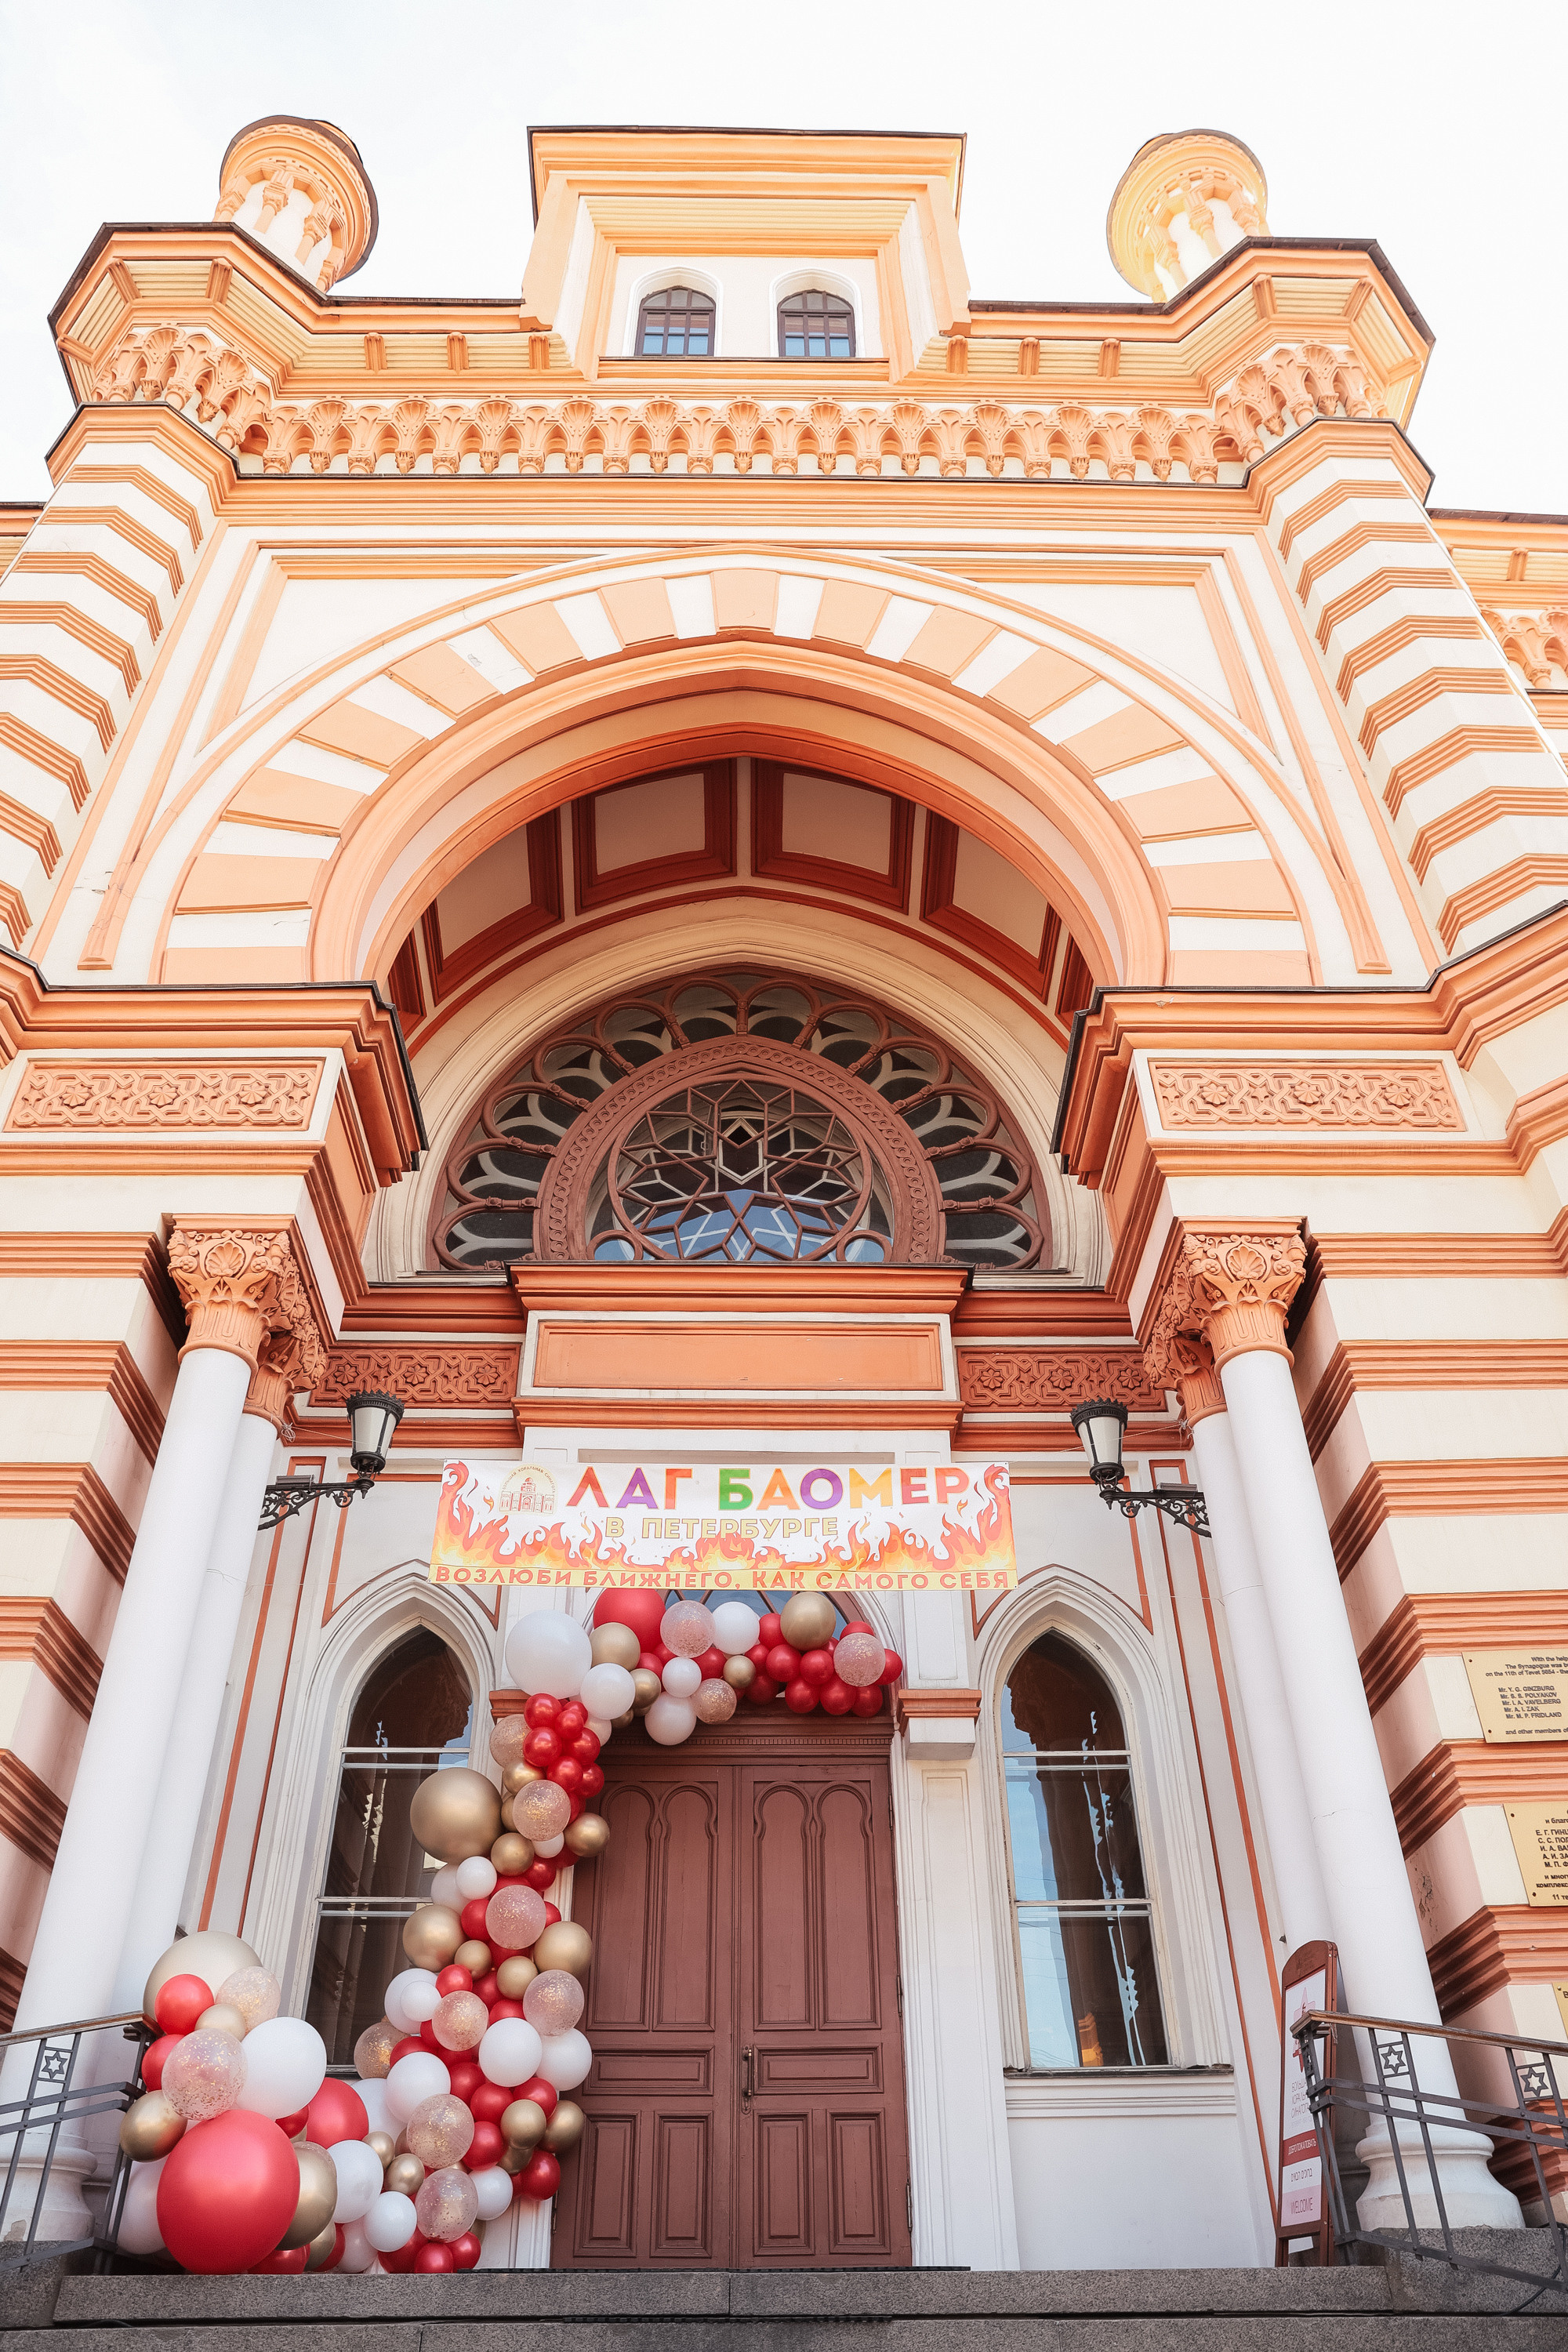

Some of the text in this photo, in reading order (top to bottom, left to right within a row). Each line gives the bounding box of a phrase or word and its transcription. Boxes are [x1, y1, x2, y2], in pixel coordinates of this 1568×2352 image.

[544, 1472, 555, 1493] СИНАГОГА
[565, 1466, 970, 1511] ЛАГ БАОМЕР
[605, 1516, 838, 1539] В ПЕТЕРБУРГЕ
[435, 1566, 1009, 1590] ВОЗЛЮБИ БЛИЖНЕГО, КАК САМОГО СЕБЯ
[1290, 2197, 1313, 2215] WELCOME
